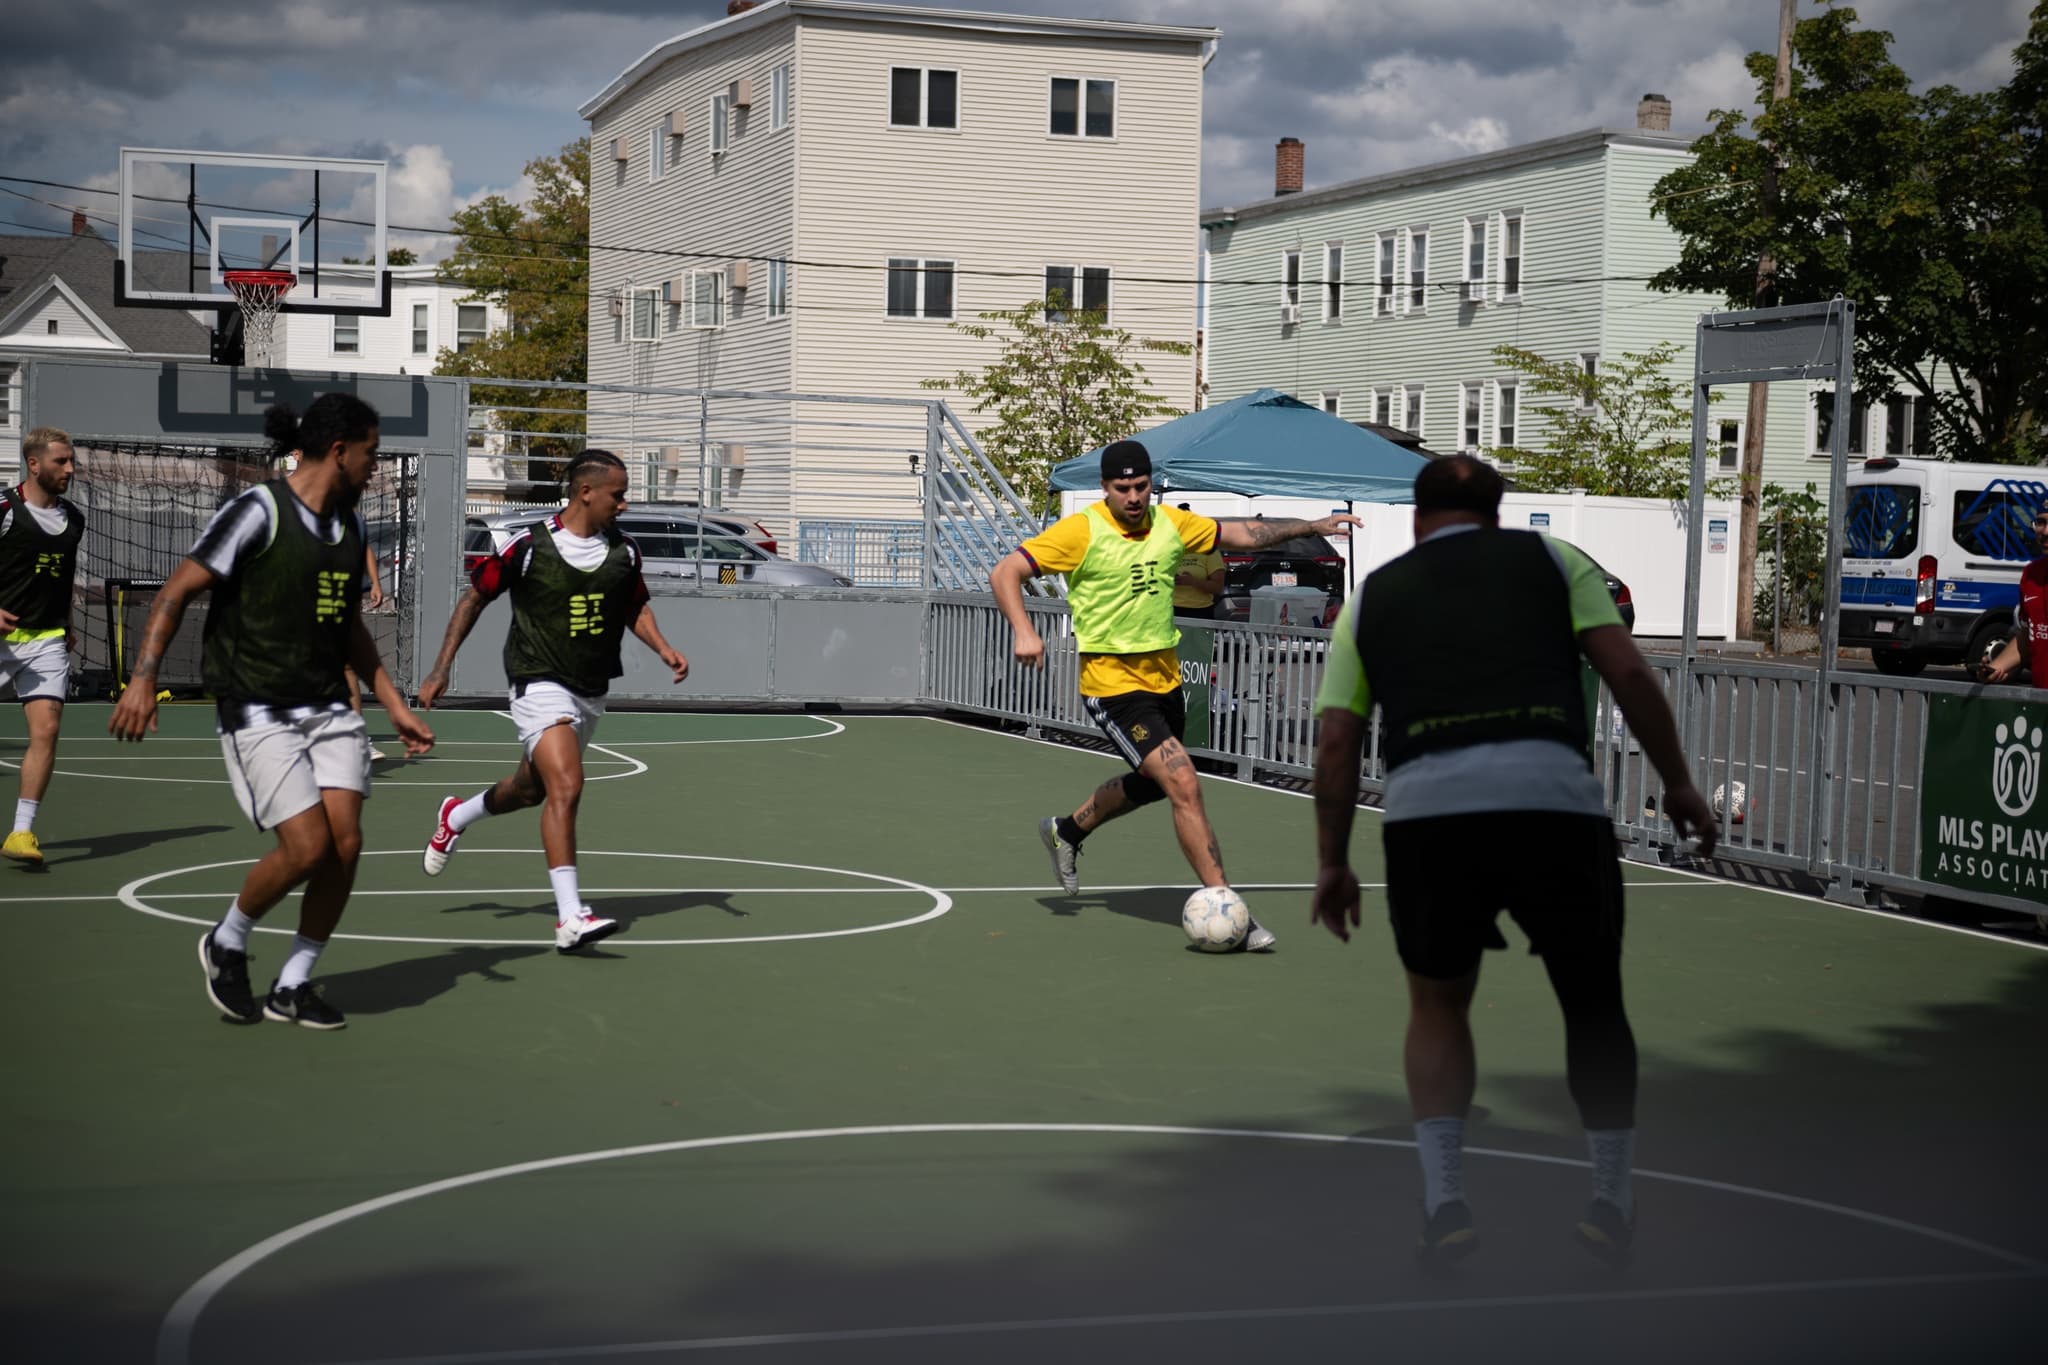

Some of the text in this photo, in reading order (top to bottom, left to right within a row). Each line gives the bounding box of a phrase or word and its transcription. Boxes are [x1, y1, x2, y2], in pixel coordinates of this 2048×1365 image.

[318, 571, 350, 597] ST
[568, 593, 604, 615] ST
[569, 615, 604, 638] FC
[1938, 815, 2048, 861] MLS PLAY
[1938, 852, 2048, 889] ASSOCIAT
